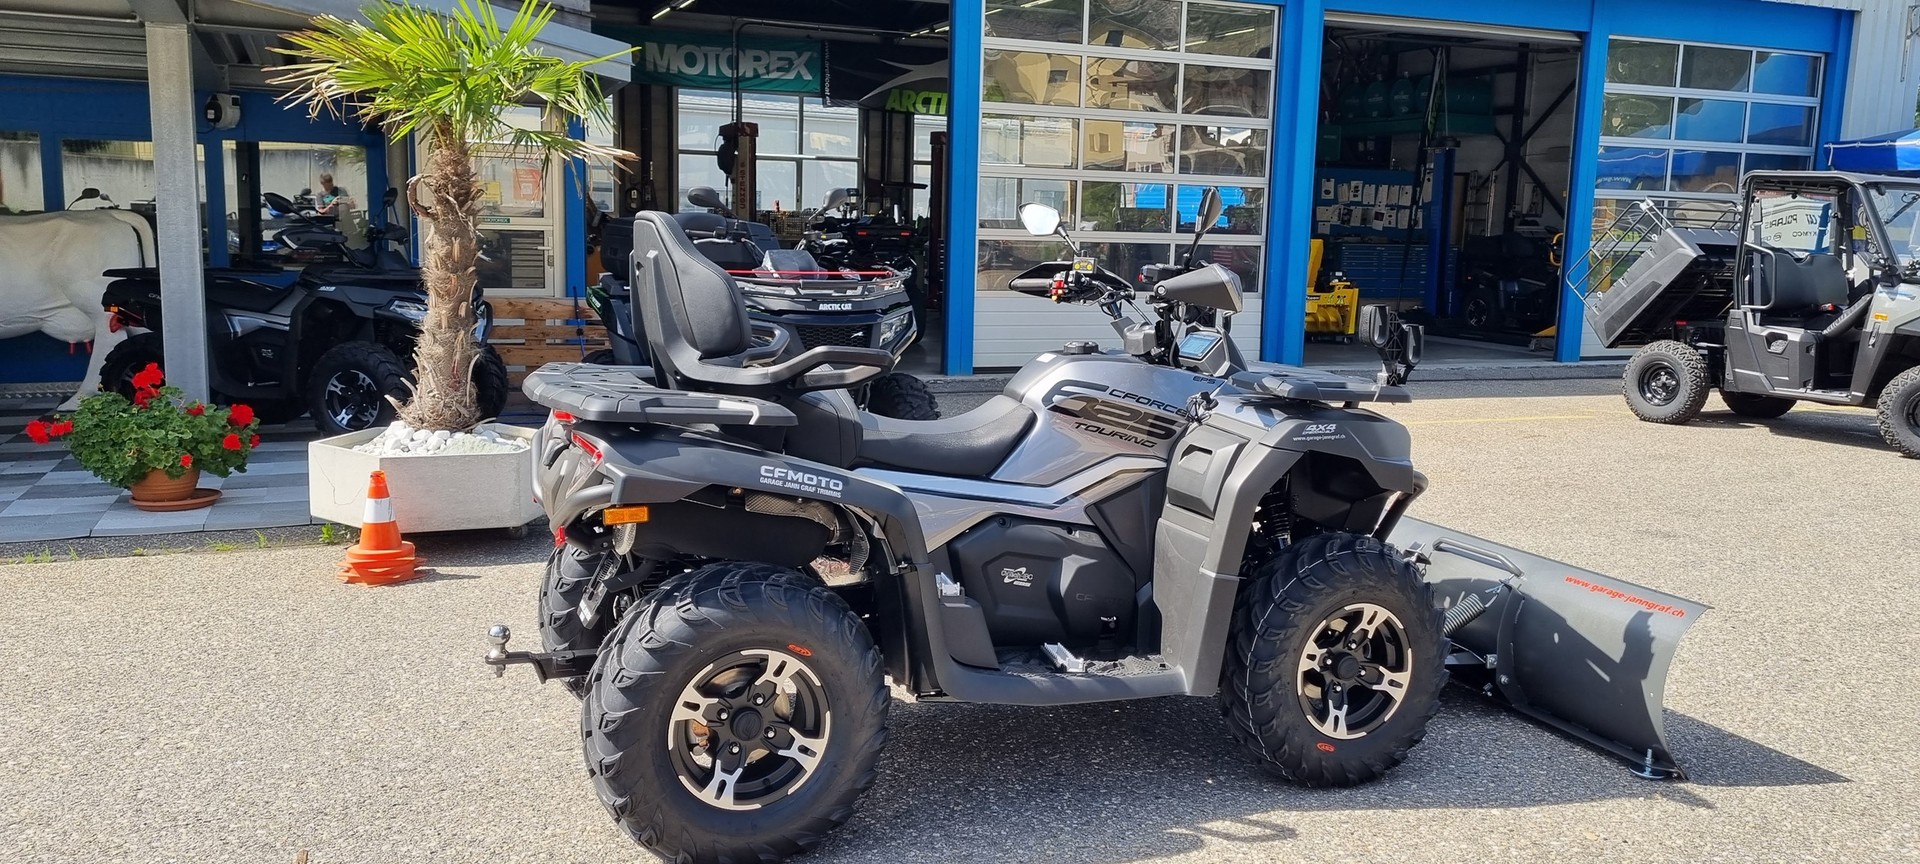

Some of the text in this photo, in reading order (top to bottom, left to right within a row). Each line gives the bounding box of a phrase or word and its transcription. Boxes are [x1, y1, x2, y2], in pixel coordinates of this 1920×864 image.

[645, 42, 813, 80] MOTOREX
[1193, 376, 1216, 384] EPS
[1074, 421, 1158, 448] TOURING
[760, 465, 843, 491] CFMOTO
[760, 477, 784, 487] GARAGE
[784, 480, 800, 490] JANN
[801, 484, 816, 493] GRAF
[1565, 575, 1686, 618] www.garage-janngraf.ch
